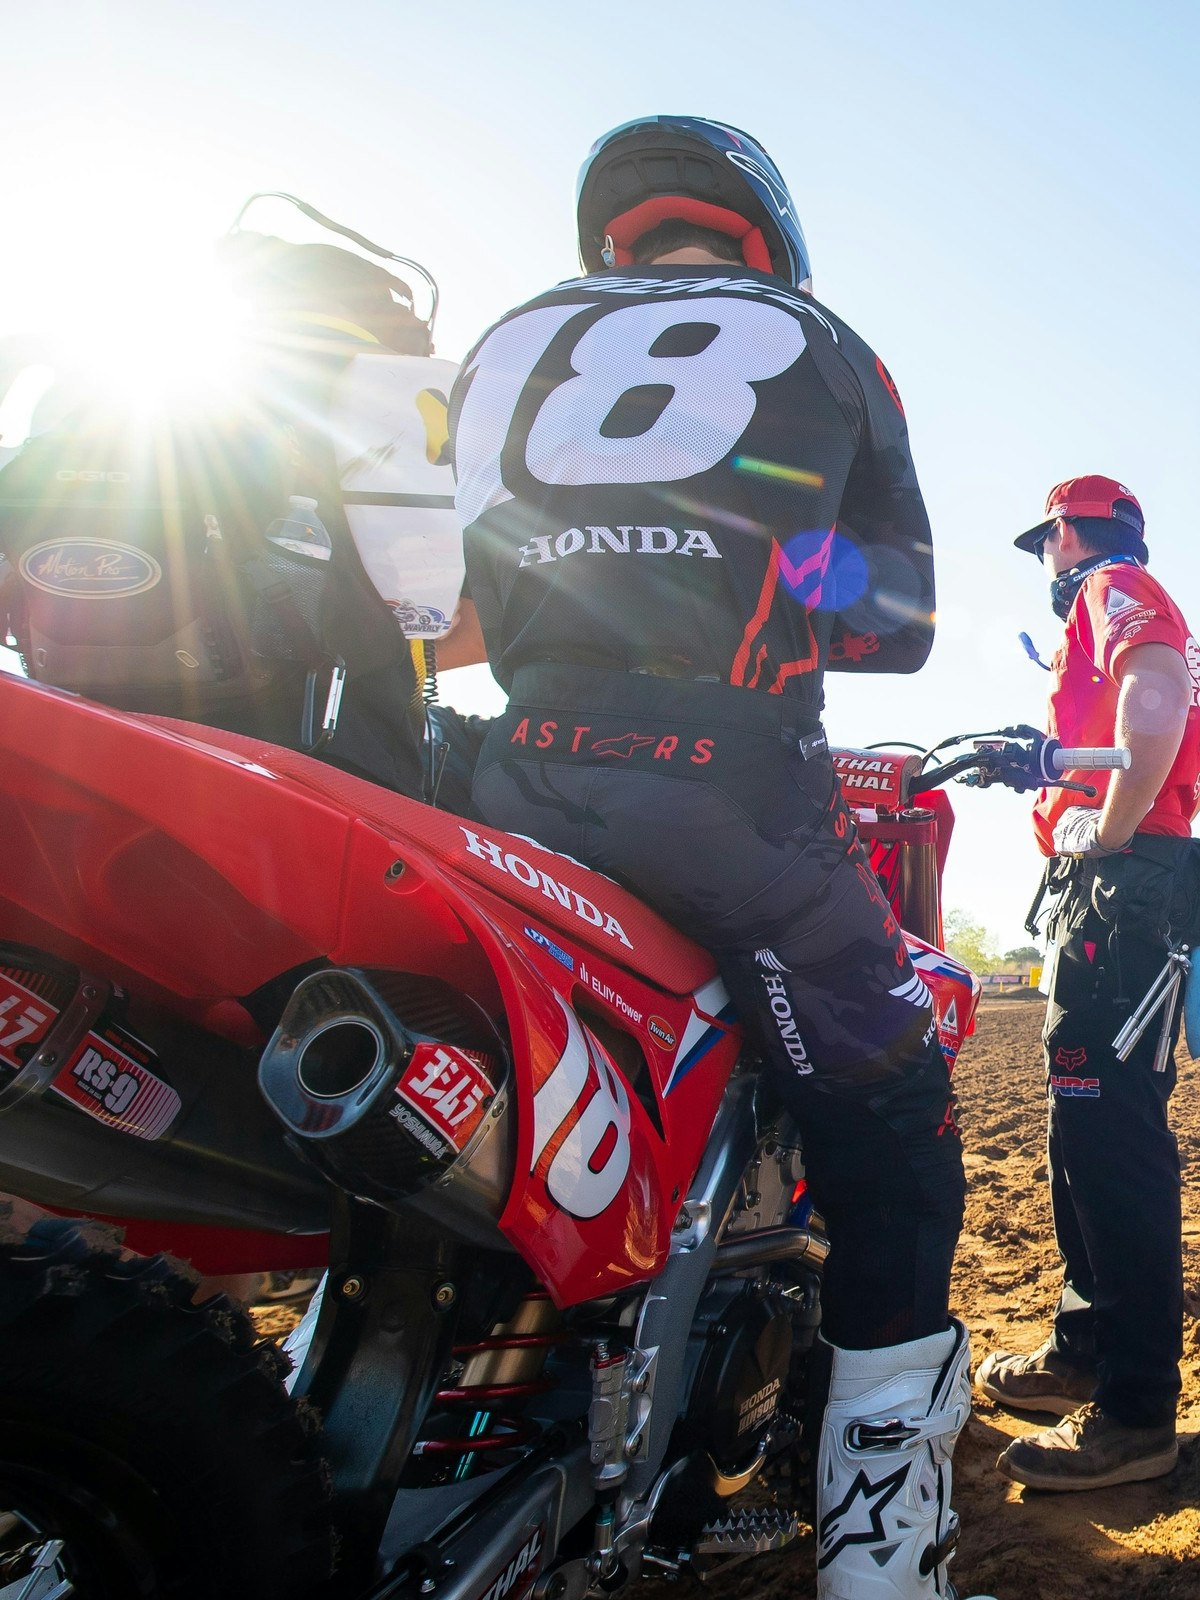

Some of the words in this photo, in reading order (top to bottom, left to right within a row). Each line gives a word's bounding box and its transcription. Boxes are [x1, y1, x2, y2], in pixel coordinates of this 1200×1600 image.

[454, 297, 808, 528] 18
[56, 470, 130, 482] OGIO
[38, 548, 96, 579] Motion
[95, 553, 135, 577] Pro
[519, 525, 722, 568] HONDA
[1073, 558, 1111, 582] CHRISTIEN
[832, 757, 895, 774] THAL
[458, 826, 634, 951] HONDA
[615, 994, 643, 1024] Power
[760, 973, 815, 1077] HONDA
[649, 1021, 665, 1039] Twin
[664, 1031, 675, 1045] Air
[73, 1047, 139, 1114] RS-9
[408, 1048, 485, 1127] ヨシムラ
[389, 1103, 447, 1160] YOSHIMURA
[739, 1378, 781, 1415] HONDA
